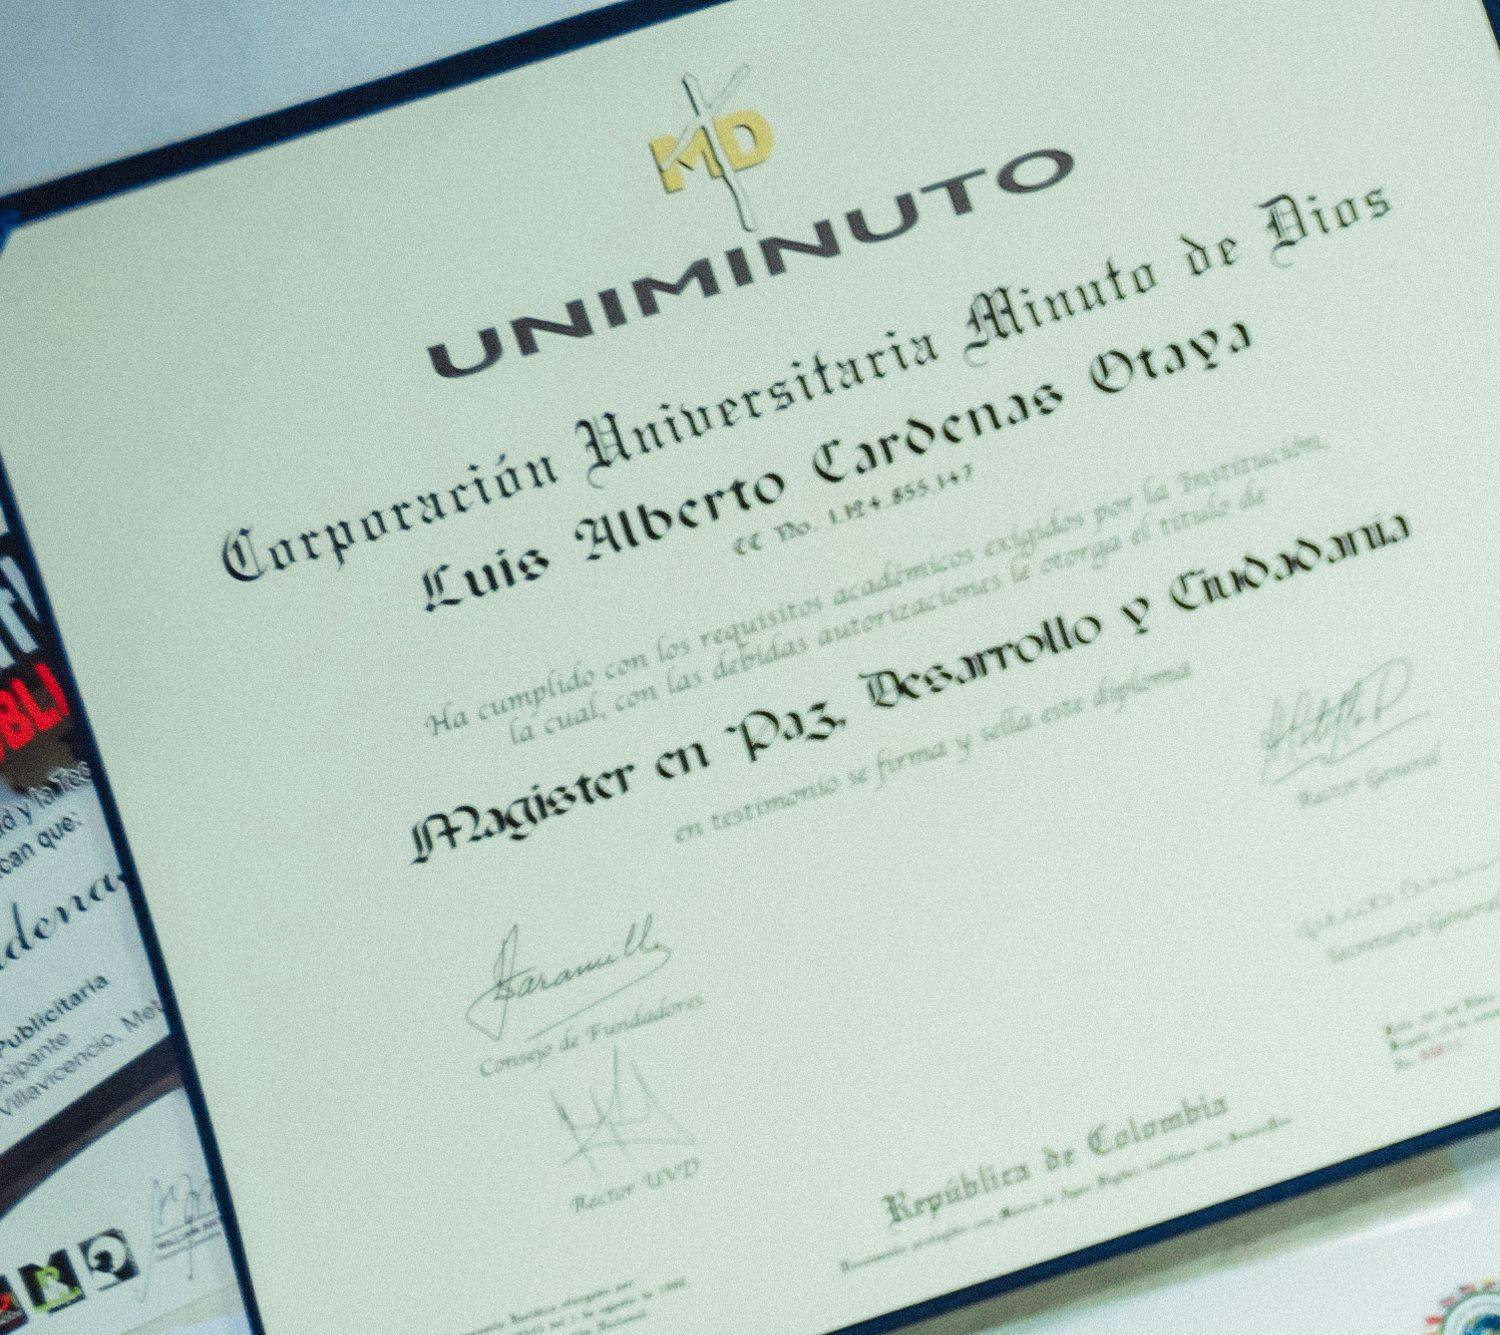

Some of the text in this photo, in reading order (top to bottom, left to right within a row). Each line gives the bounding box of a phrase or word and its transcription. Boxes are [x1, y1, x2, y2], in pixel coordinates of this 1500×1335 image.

[220, 181, 1392, 582] Corporación Universitaria Minuto de Dios
[427, 148, 1074, 380] UNIMINUTO
[422, 319, 1253, 612] Luis Alberto Cardenas Otaya
[409, 760, 636, 866] Magister
[655, 739, 710, 781] en
[859, 614, 1105, 711] Desarrollo
[1121, 598, 1152, 637] y
